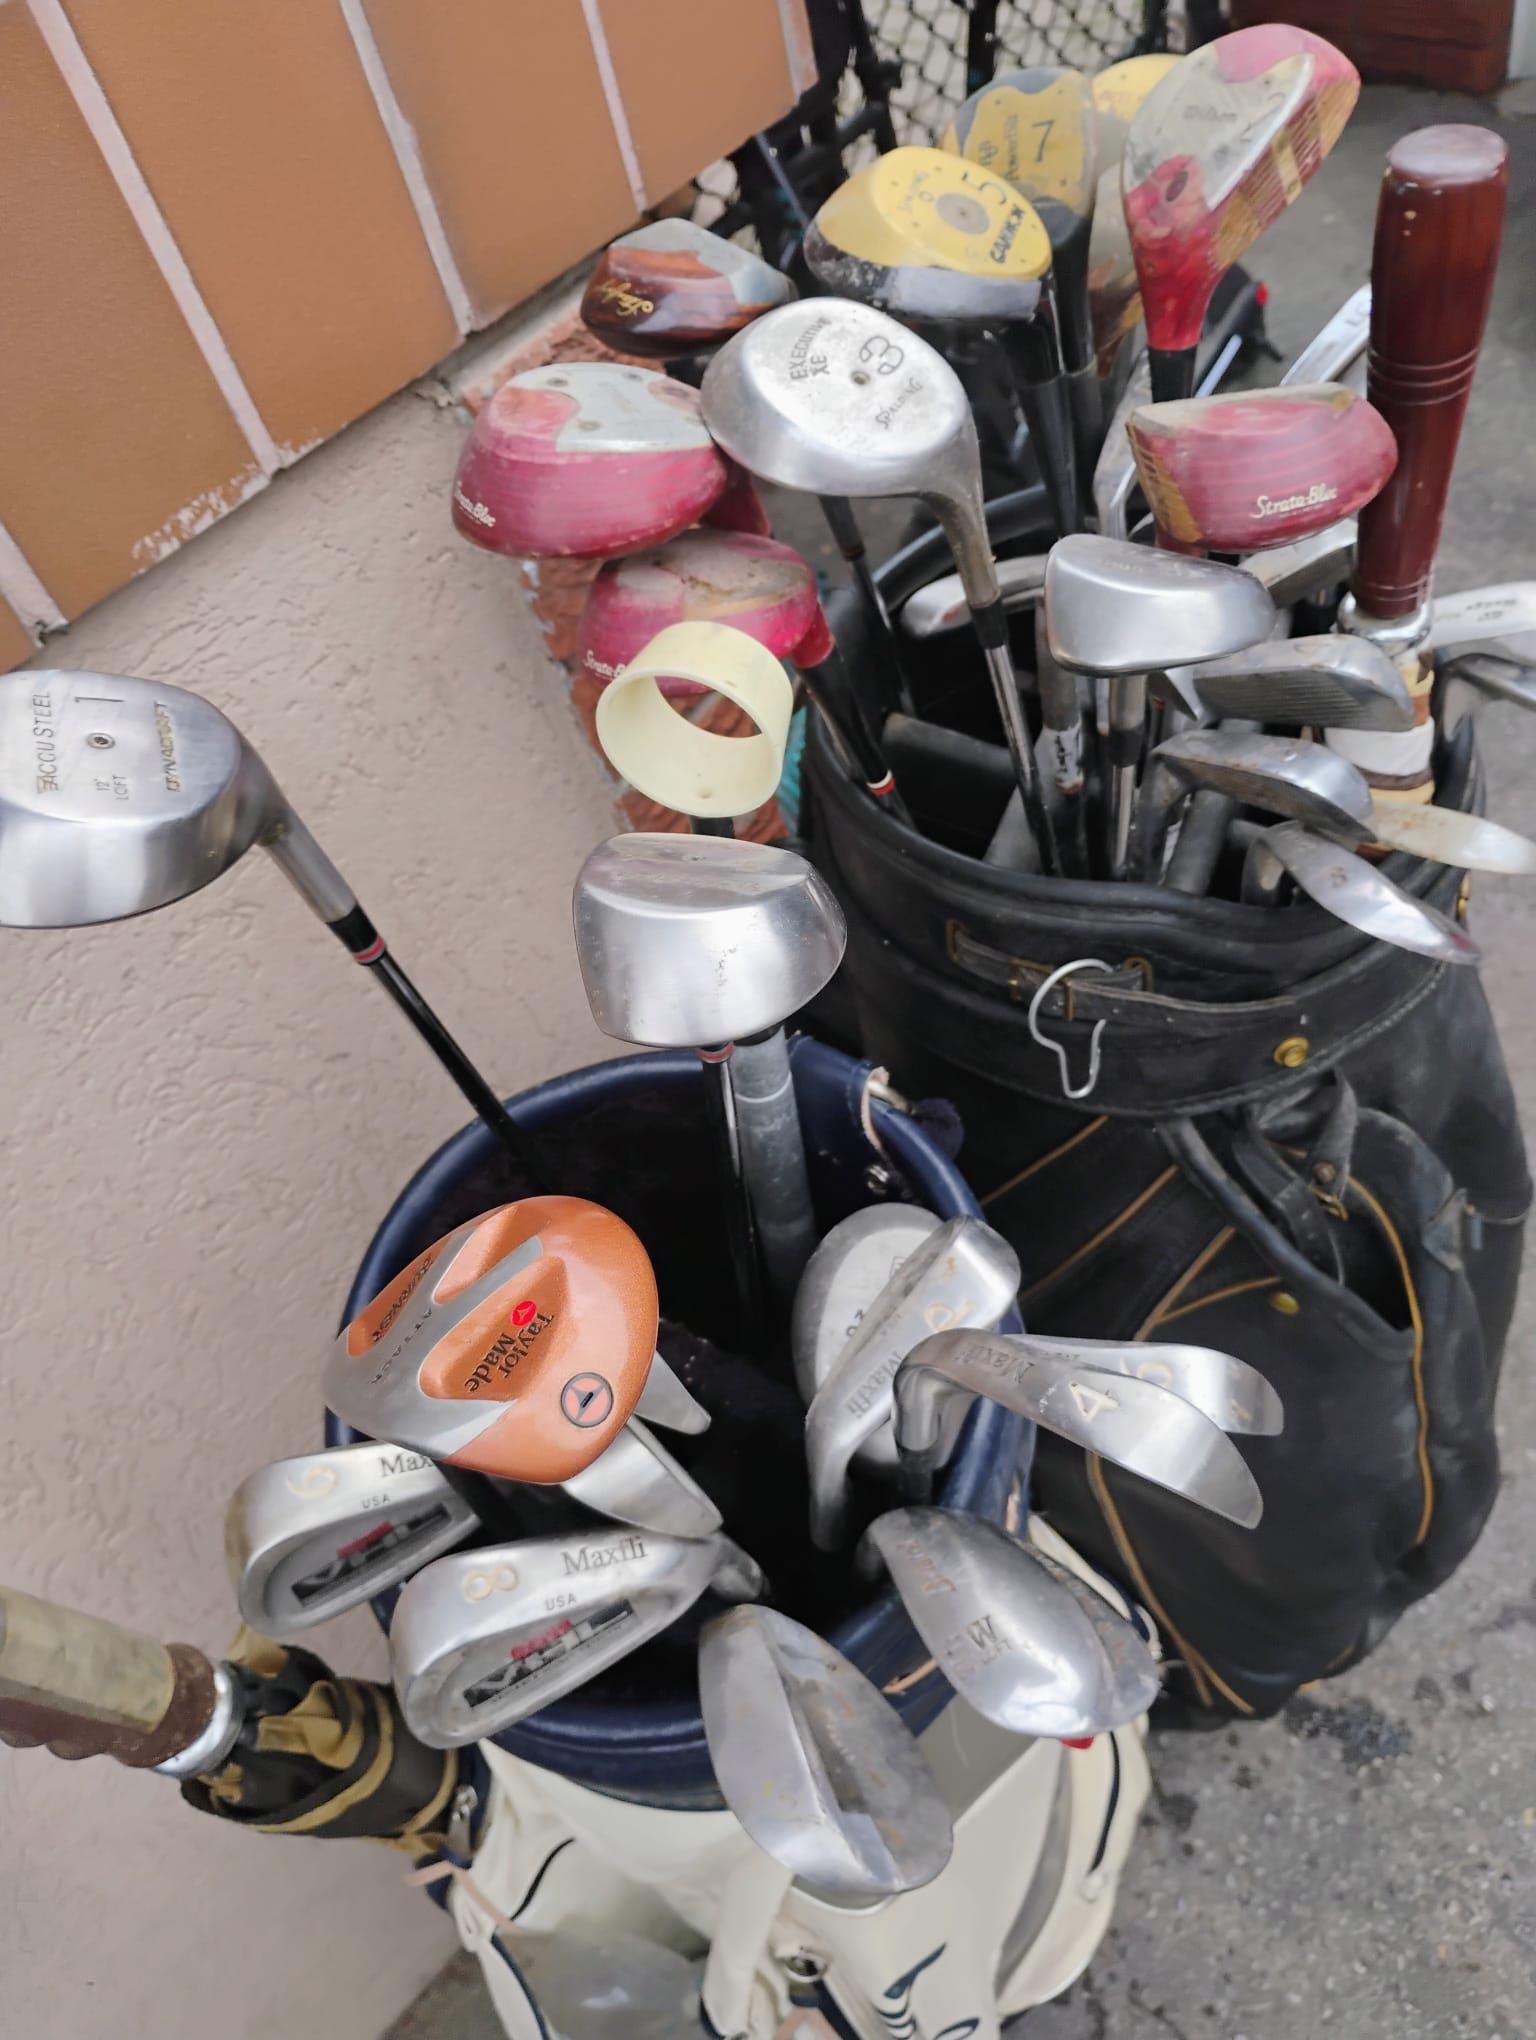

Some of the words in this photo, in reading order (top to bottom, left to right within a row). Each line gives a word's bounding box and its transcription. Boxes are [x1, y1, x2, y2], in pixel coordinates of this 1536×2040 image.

[1030, 118, 1056, 164] 7
[960, 171, 1008, 206] 5
[789, 315, 833, 381] EXECUTIVE
[858, 335, 905, 376] 3
[464, 1332, 516, 1392] Made
[497, 1312, 555, 1379] Taylor
[845, 1350, 905, 1419] Maxfli
[378, 1453, 435, 1478] Max
[361, 1492, 392, 1510] USA
[561, 1535, 649, 1576] Maxfli
[463, 1560, 520, 1604] 8
[544, 1592, 578, 1612] USA
